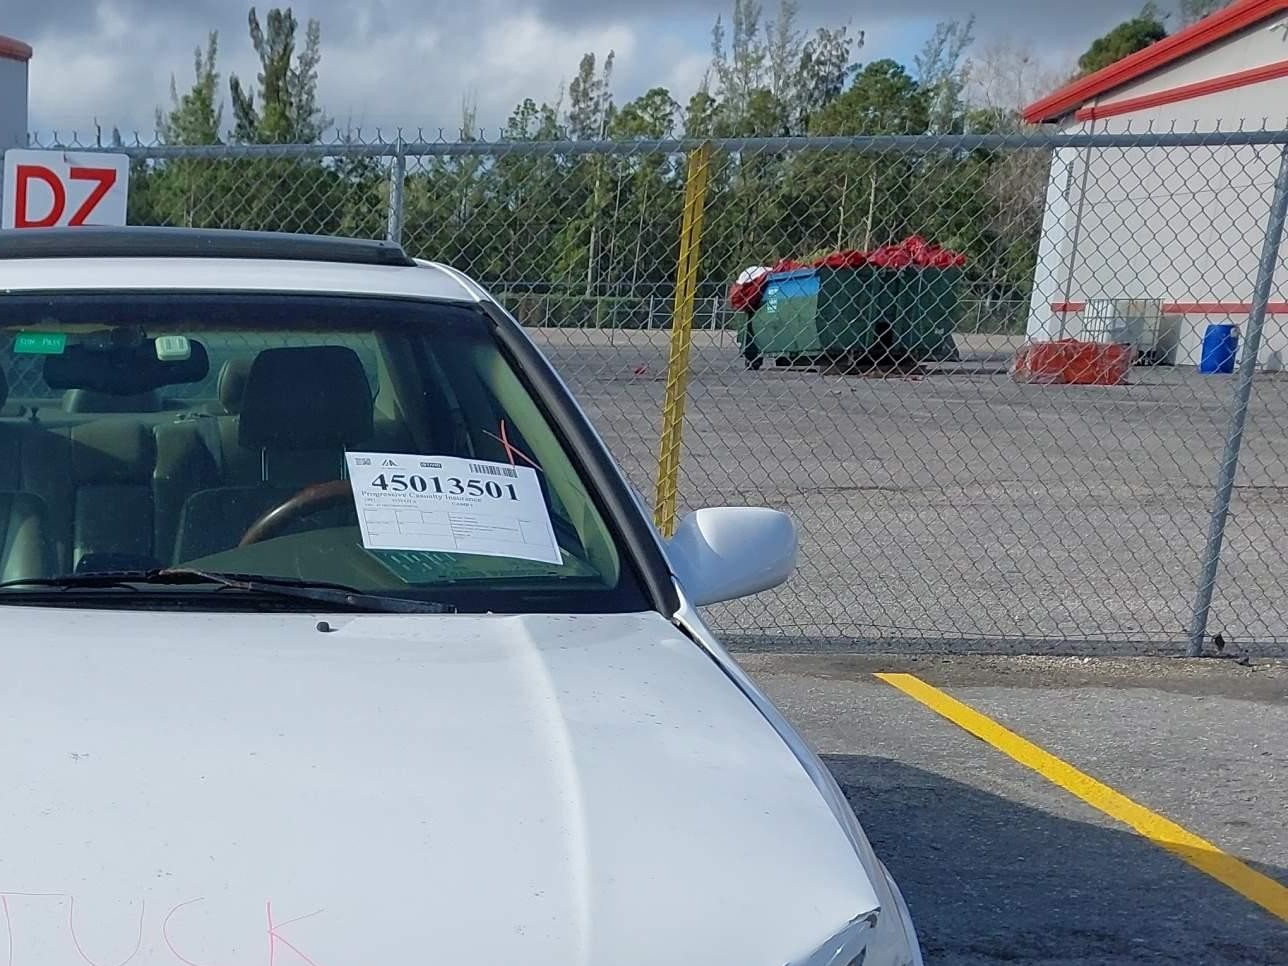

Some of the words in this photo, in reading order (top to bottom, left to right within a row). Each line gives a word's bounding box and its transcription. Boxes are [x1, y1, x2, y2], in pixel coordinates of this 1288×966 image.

[361, 490, 407, 499] Progressive
[409, 492, 443, 501] Casualty
[445, 494, 482, 503] Insurance
[371, 473, 521, 502] 45013501
